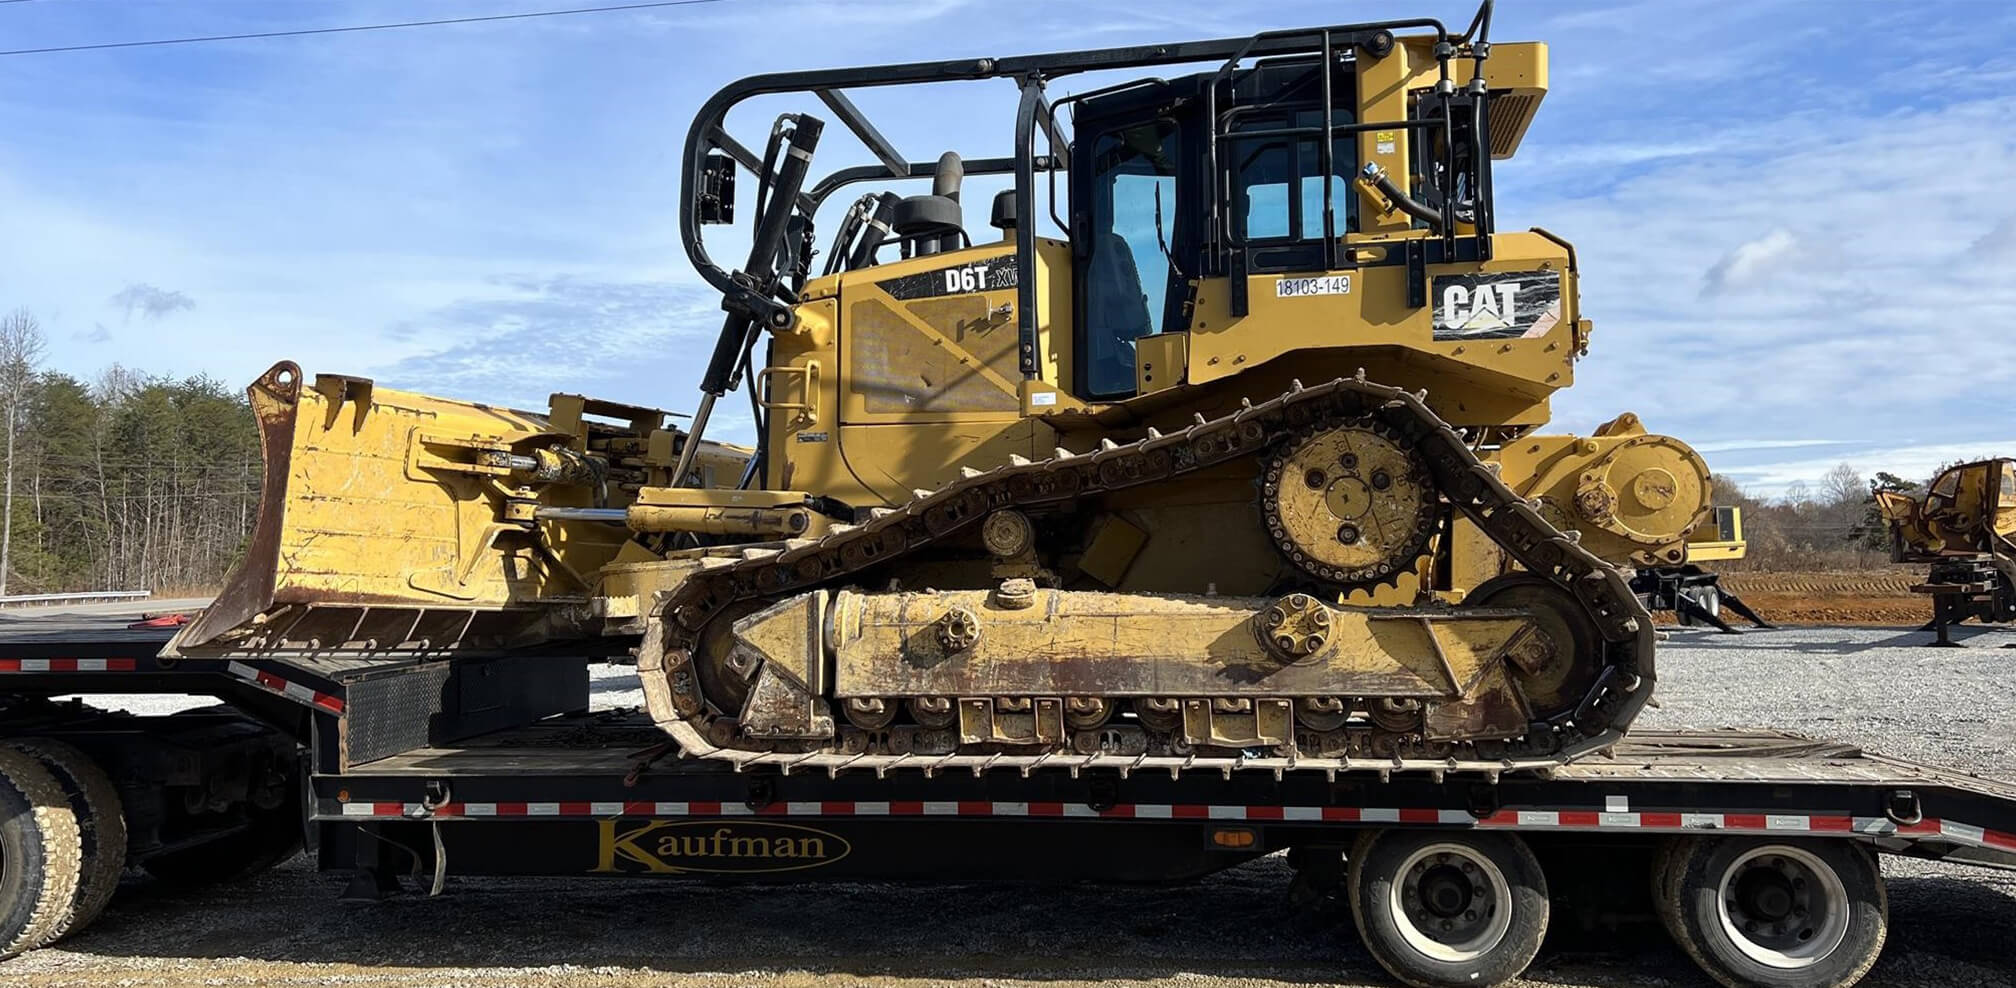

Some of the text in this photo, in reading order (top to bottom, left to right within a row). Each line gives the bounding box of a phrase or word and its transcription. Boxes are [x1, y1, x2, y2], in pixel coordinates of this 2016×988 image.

[945, 266, 989, 292] D6T
[1277, 277, 1349, 295] 18103-149
[1443, 283, 1521, 330] CAT
[586, 818, 827, 874] Kaufman
